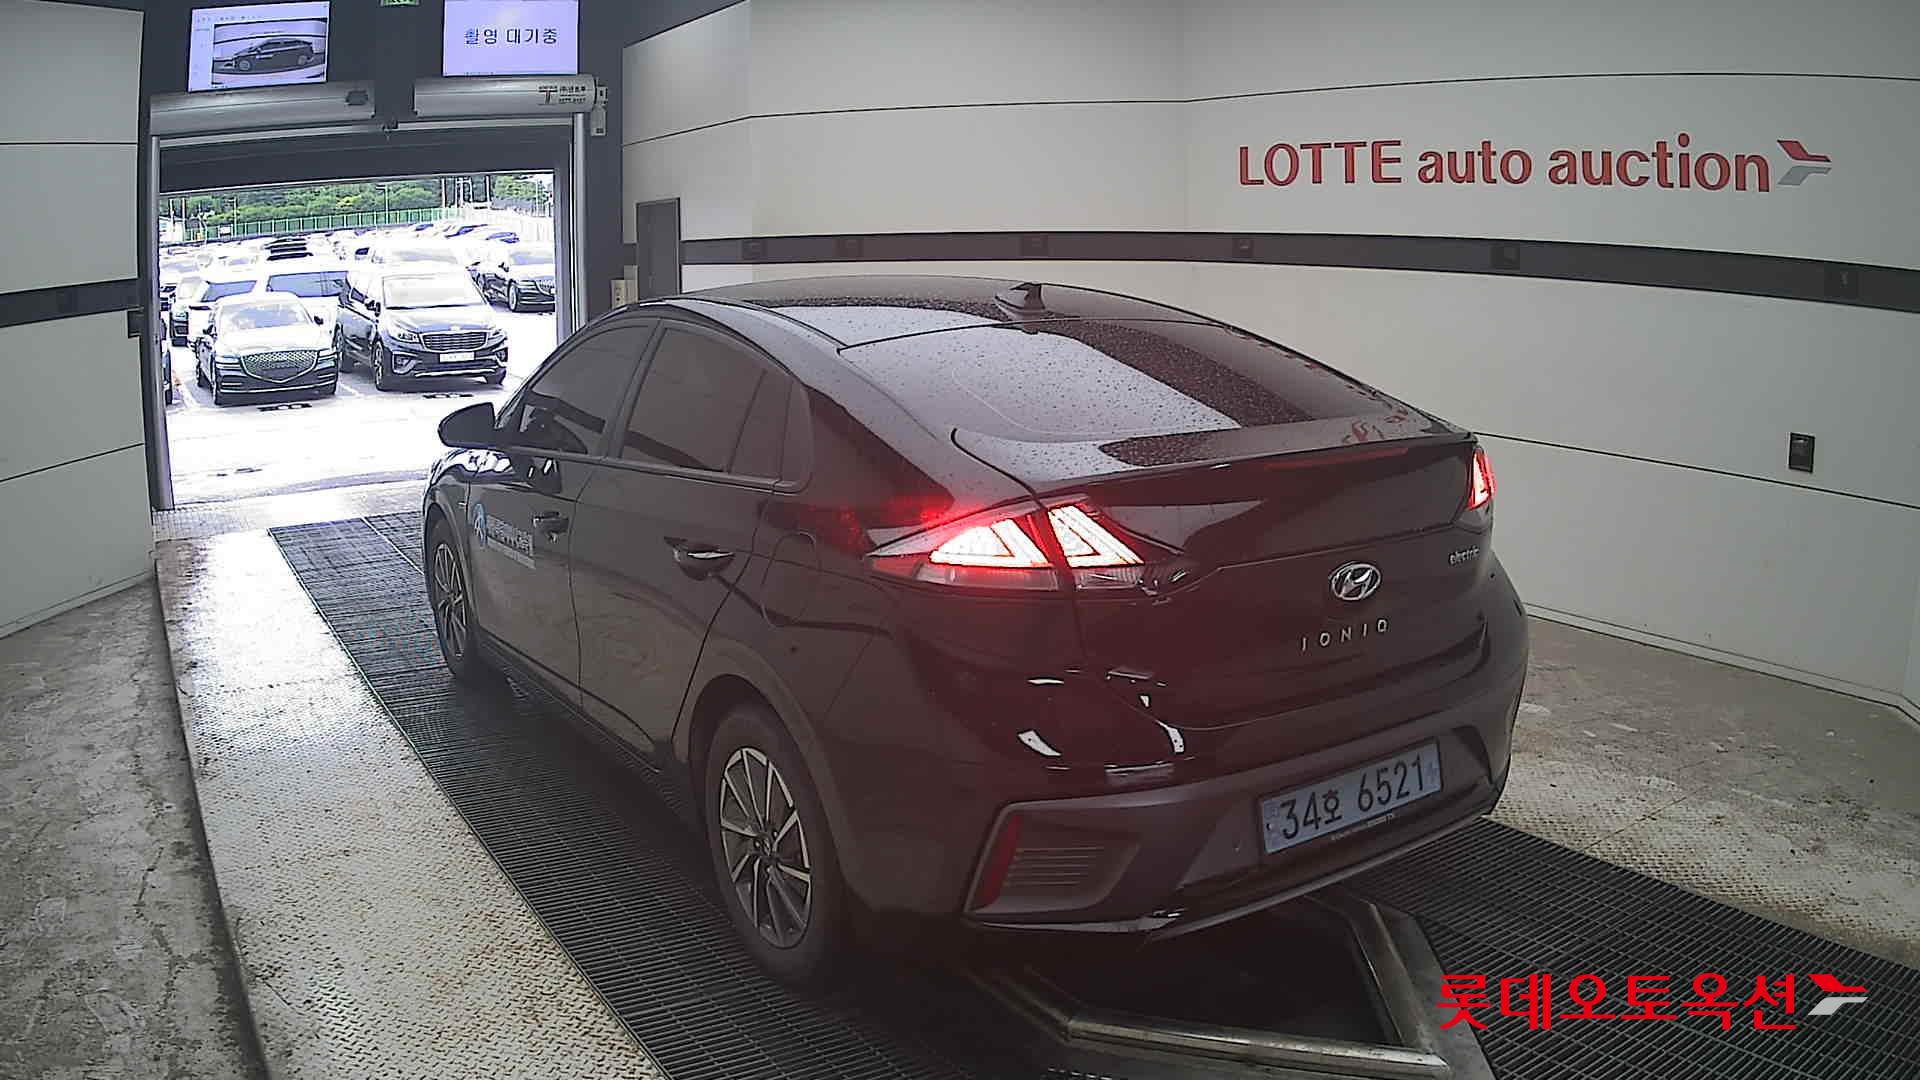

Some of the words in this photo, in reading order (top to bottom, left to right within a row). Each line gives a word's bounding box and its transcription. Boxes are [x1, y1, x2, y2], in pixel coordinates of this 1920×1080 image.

[506, 28, 557, 45] 대기중
[1238, 140, 1402, 186] LOTTE
[1417, 140, 1533, 185] auto
[1548, 132, 1771, 193] auction
[1280, 789, 1343, 840] 34호
[1357, 753, 1424, 813] 6521
